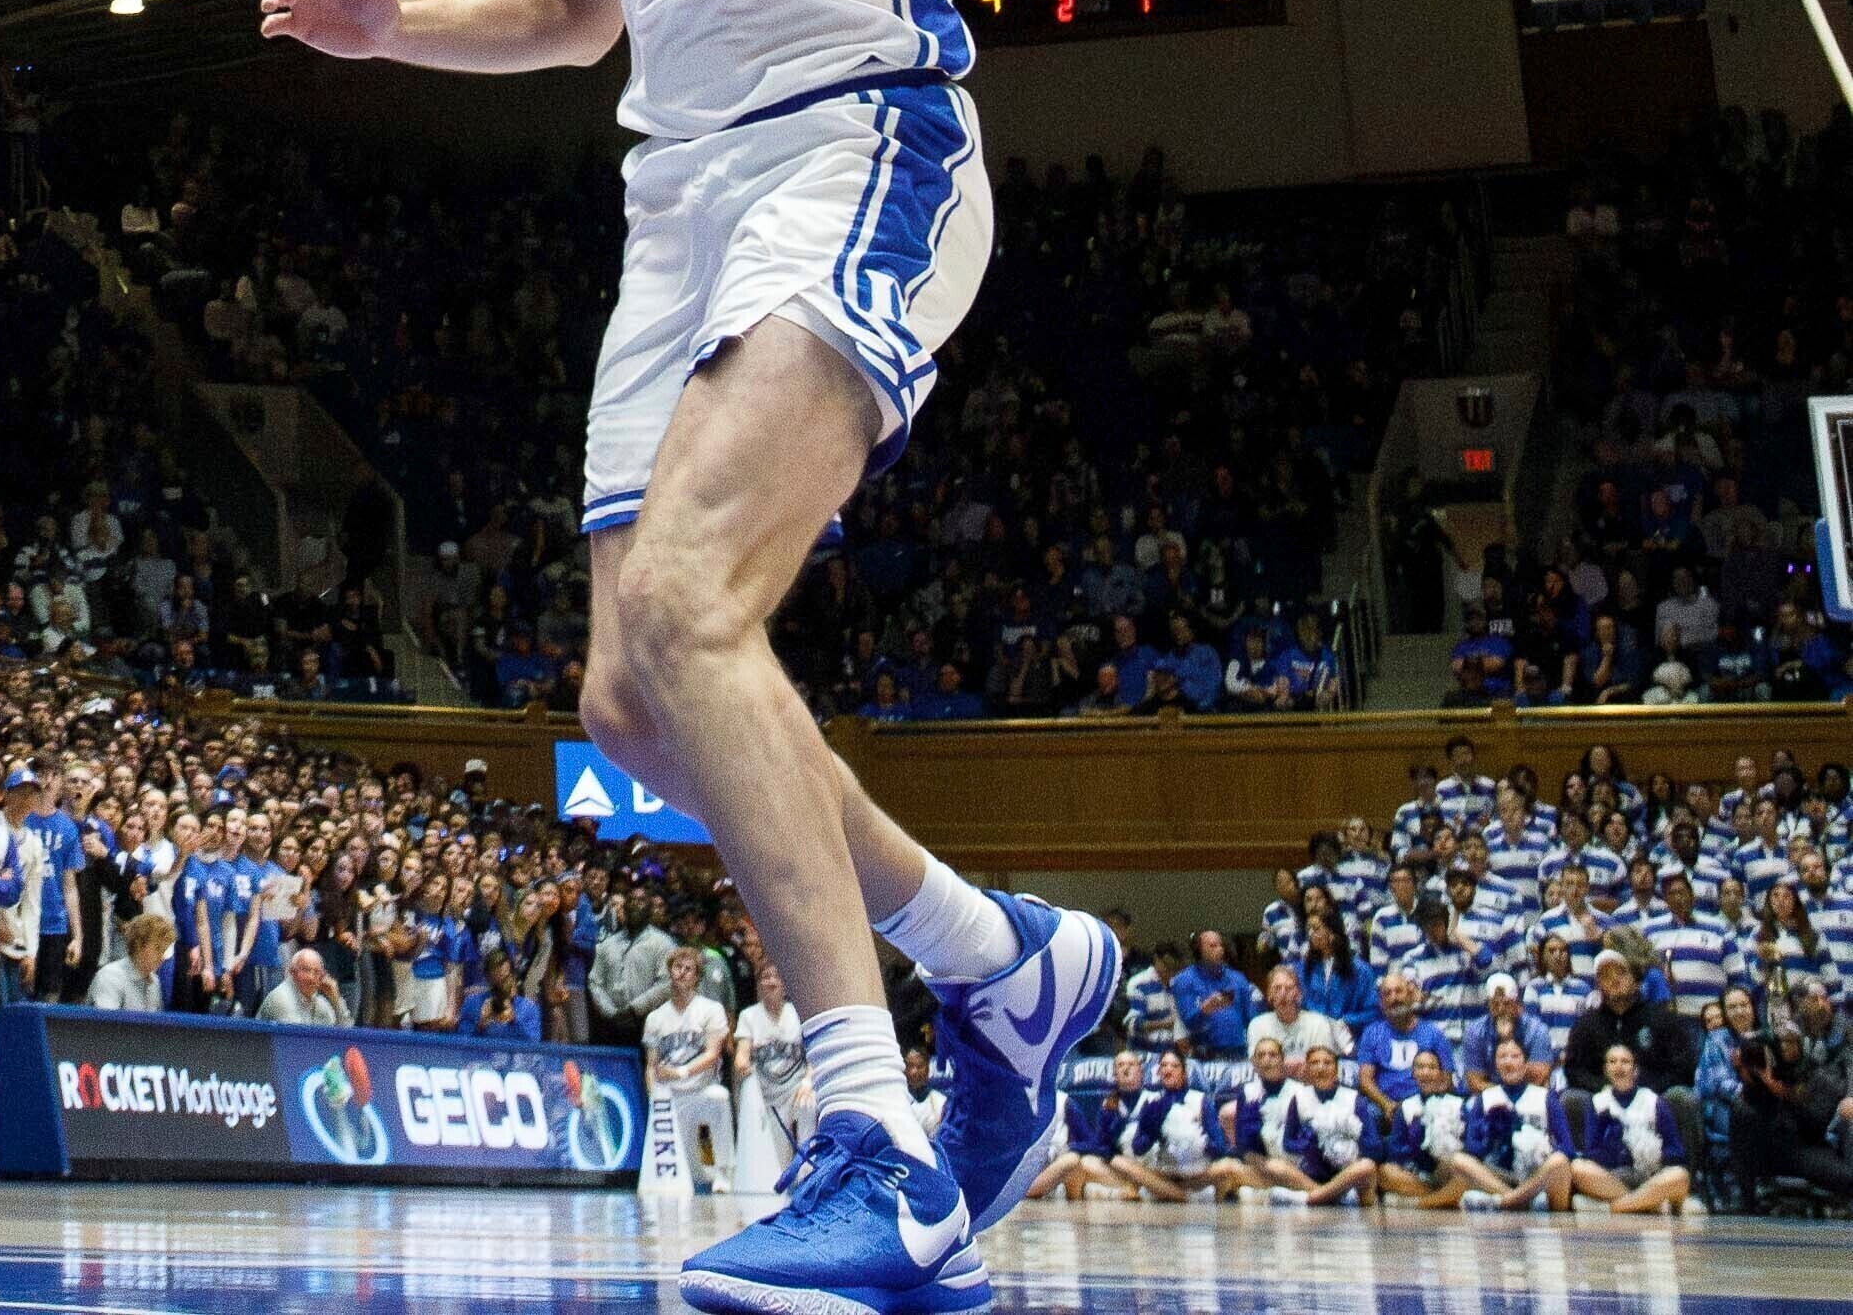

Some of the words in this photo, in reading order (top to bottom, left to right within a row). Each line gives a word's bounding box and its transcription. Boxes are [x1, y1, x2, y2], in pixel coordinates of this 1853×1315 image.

[58, 1061, 167, 1113] ROCKET
[167, 1067, 278, 1129] Mortgage
[396, 1065, 549, 1149] GEICO
[653, 1099, 677, 1178] DUKE
